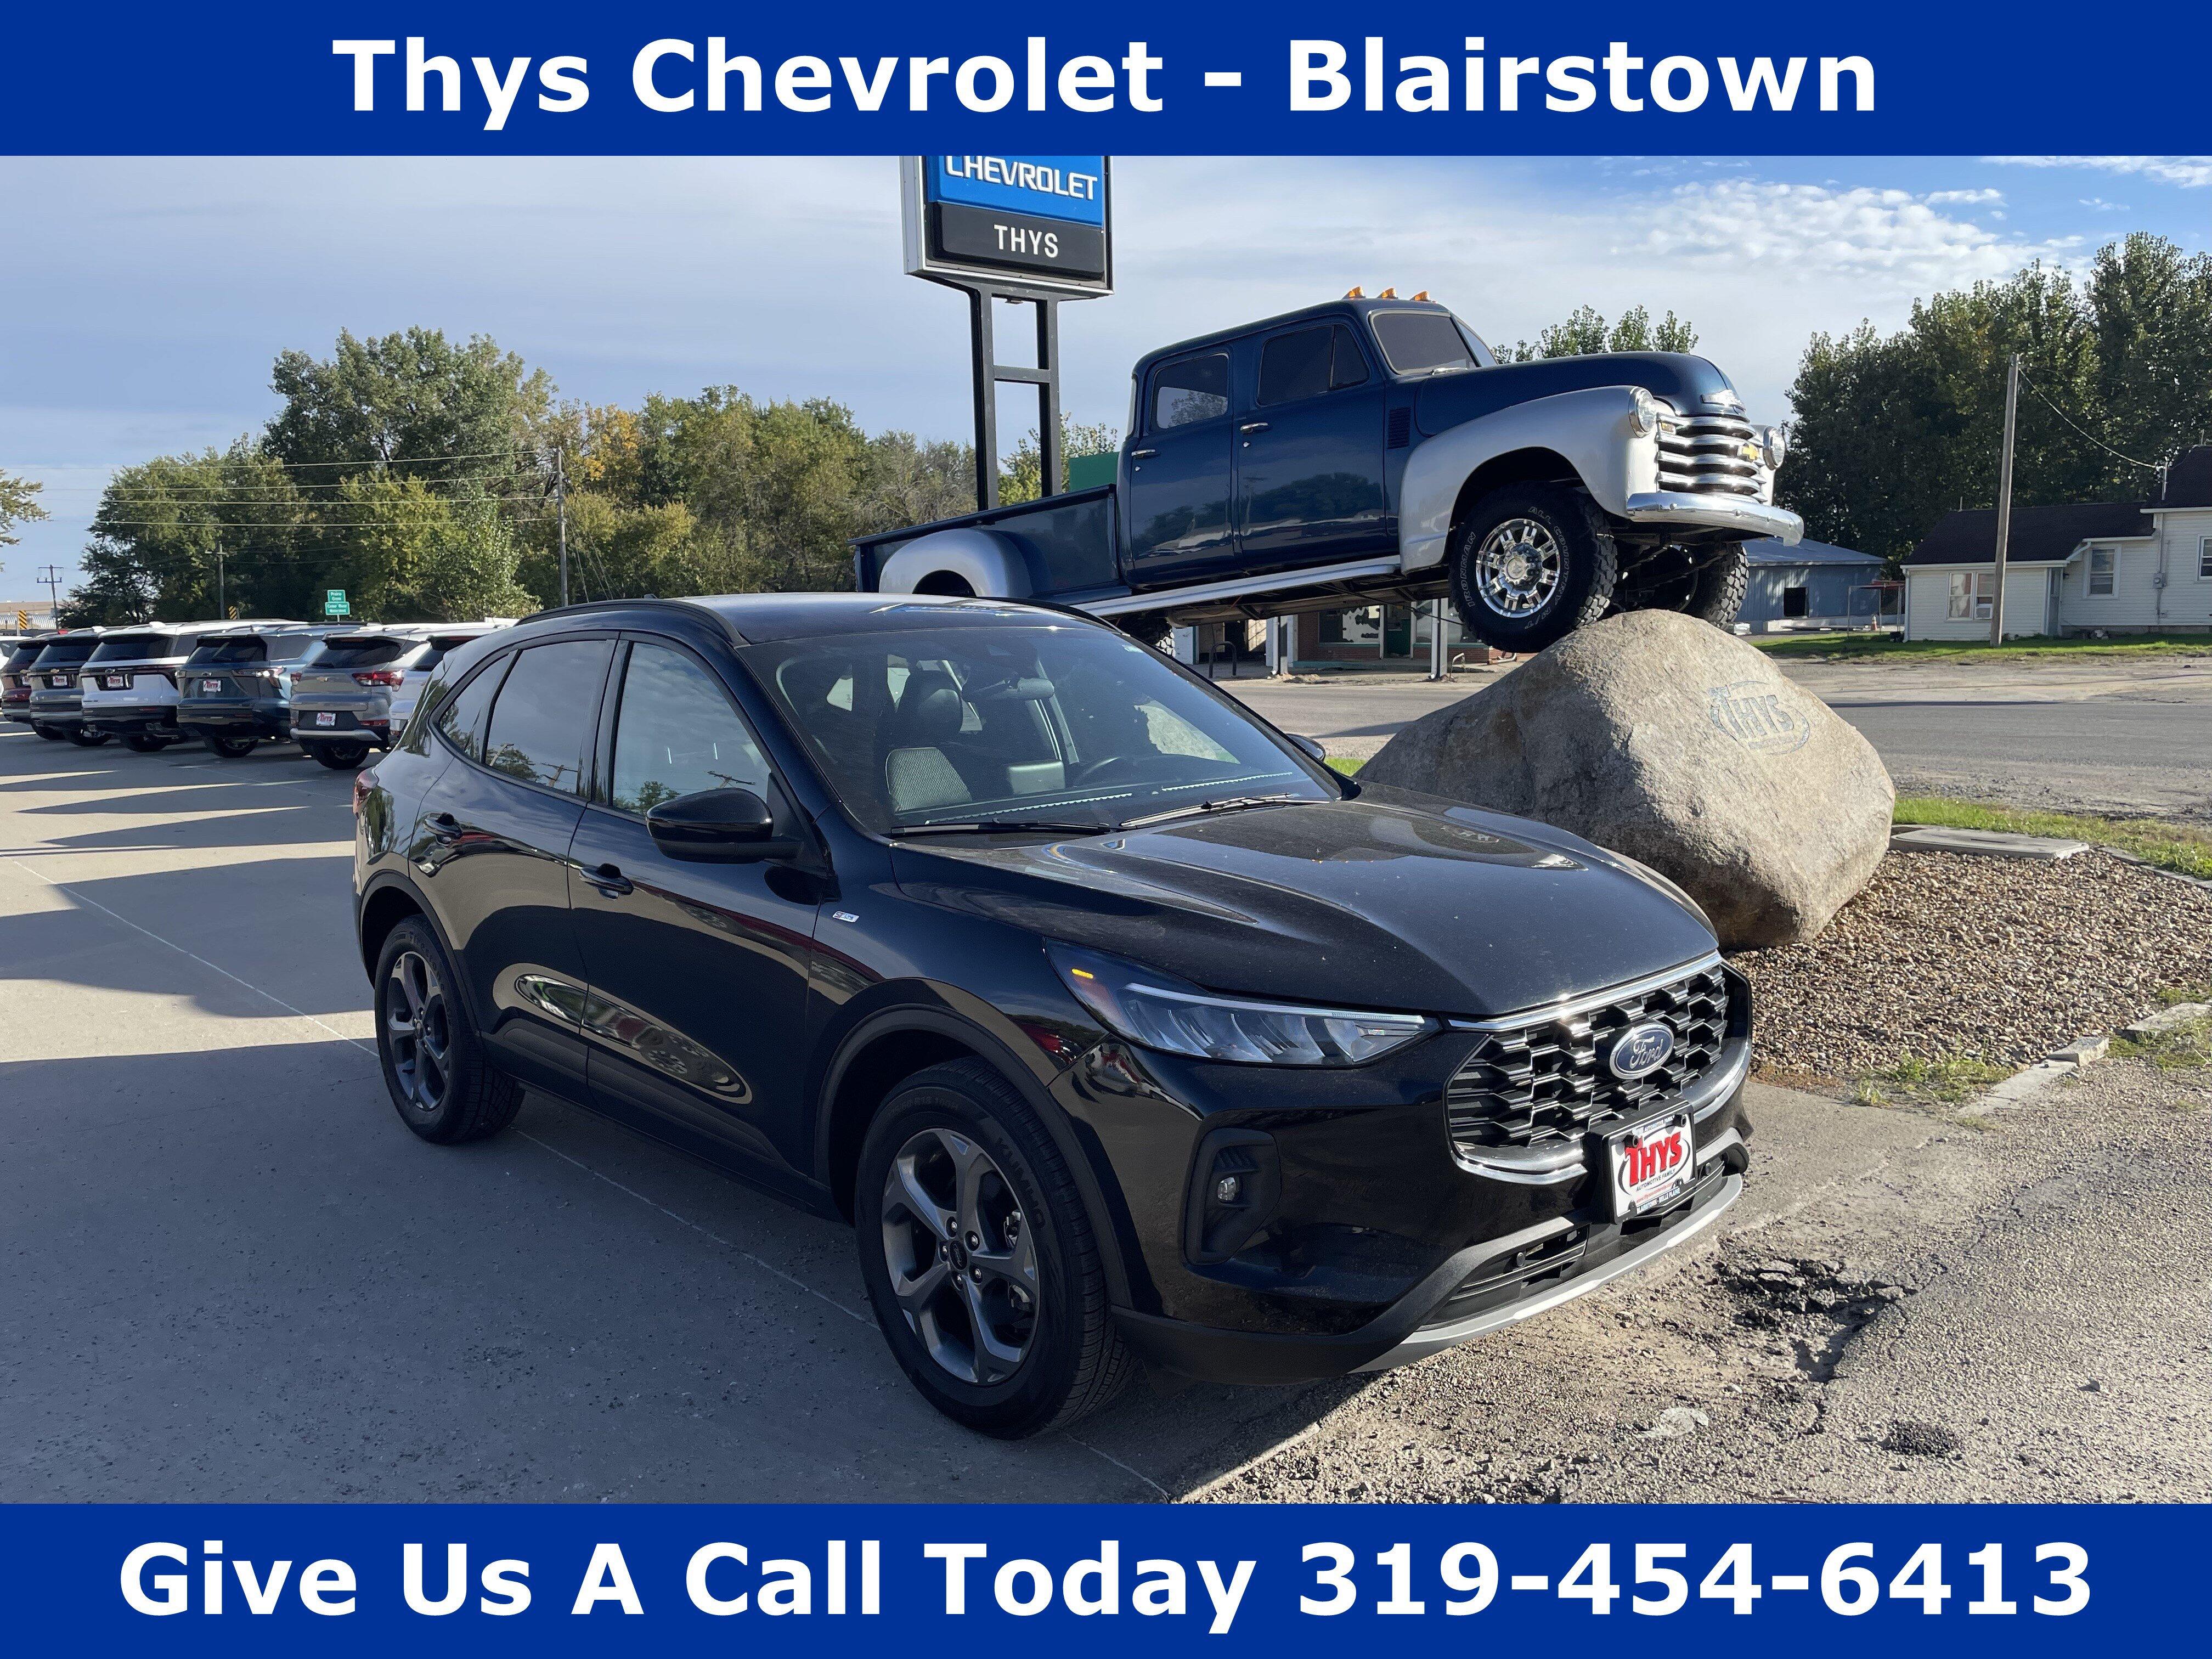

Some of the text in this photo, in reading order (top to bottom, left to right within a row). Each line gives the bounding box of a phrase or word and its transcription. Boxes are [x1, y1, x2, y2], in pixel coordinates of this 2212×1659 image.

[946, 156, 1098, 200] CHEVROLET
[994, 224, 1059, 258] THYS
[1528, 506, 1551, 524] ALL
[1460, 531, 1477, 607] IRONMAN
[1707, 684, 1795, 739] THYS
[1629, 1036, 1664, 1069] Ford
[996, 1137, 1046, 1229] KUMHO
[1624, 1132, 1683, 1187] THYS
